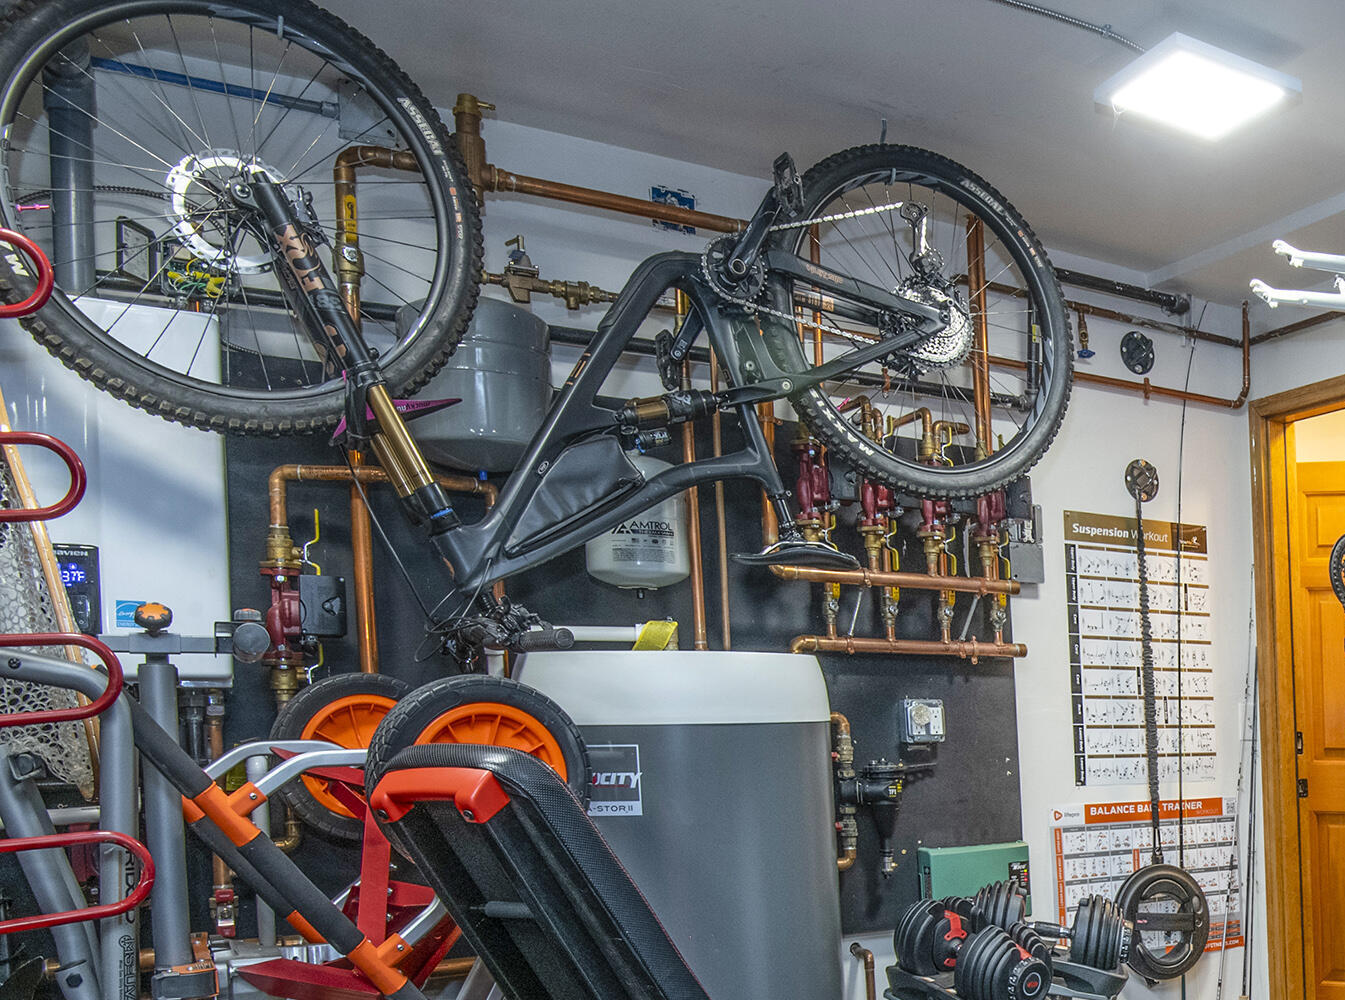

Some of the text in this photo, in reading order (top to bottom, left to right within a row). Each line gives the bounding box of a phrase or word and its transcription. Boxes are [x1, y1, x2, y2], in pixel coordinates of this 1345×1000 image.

[397, 96, 445, 156] ASSEGAI
[809, 387, 875, 457] MAXXIS
[629, 520, 673, 531] AMTROL
[1072, 523, 1129, 538] Suspension
[1131, 529, 1169, 543] Wrkout
[592, 772, 642, 788] OCITY
[1090, 805, 1136, 816] BALANCE
[1162, 801, 1203, 811] TRAINER
